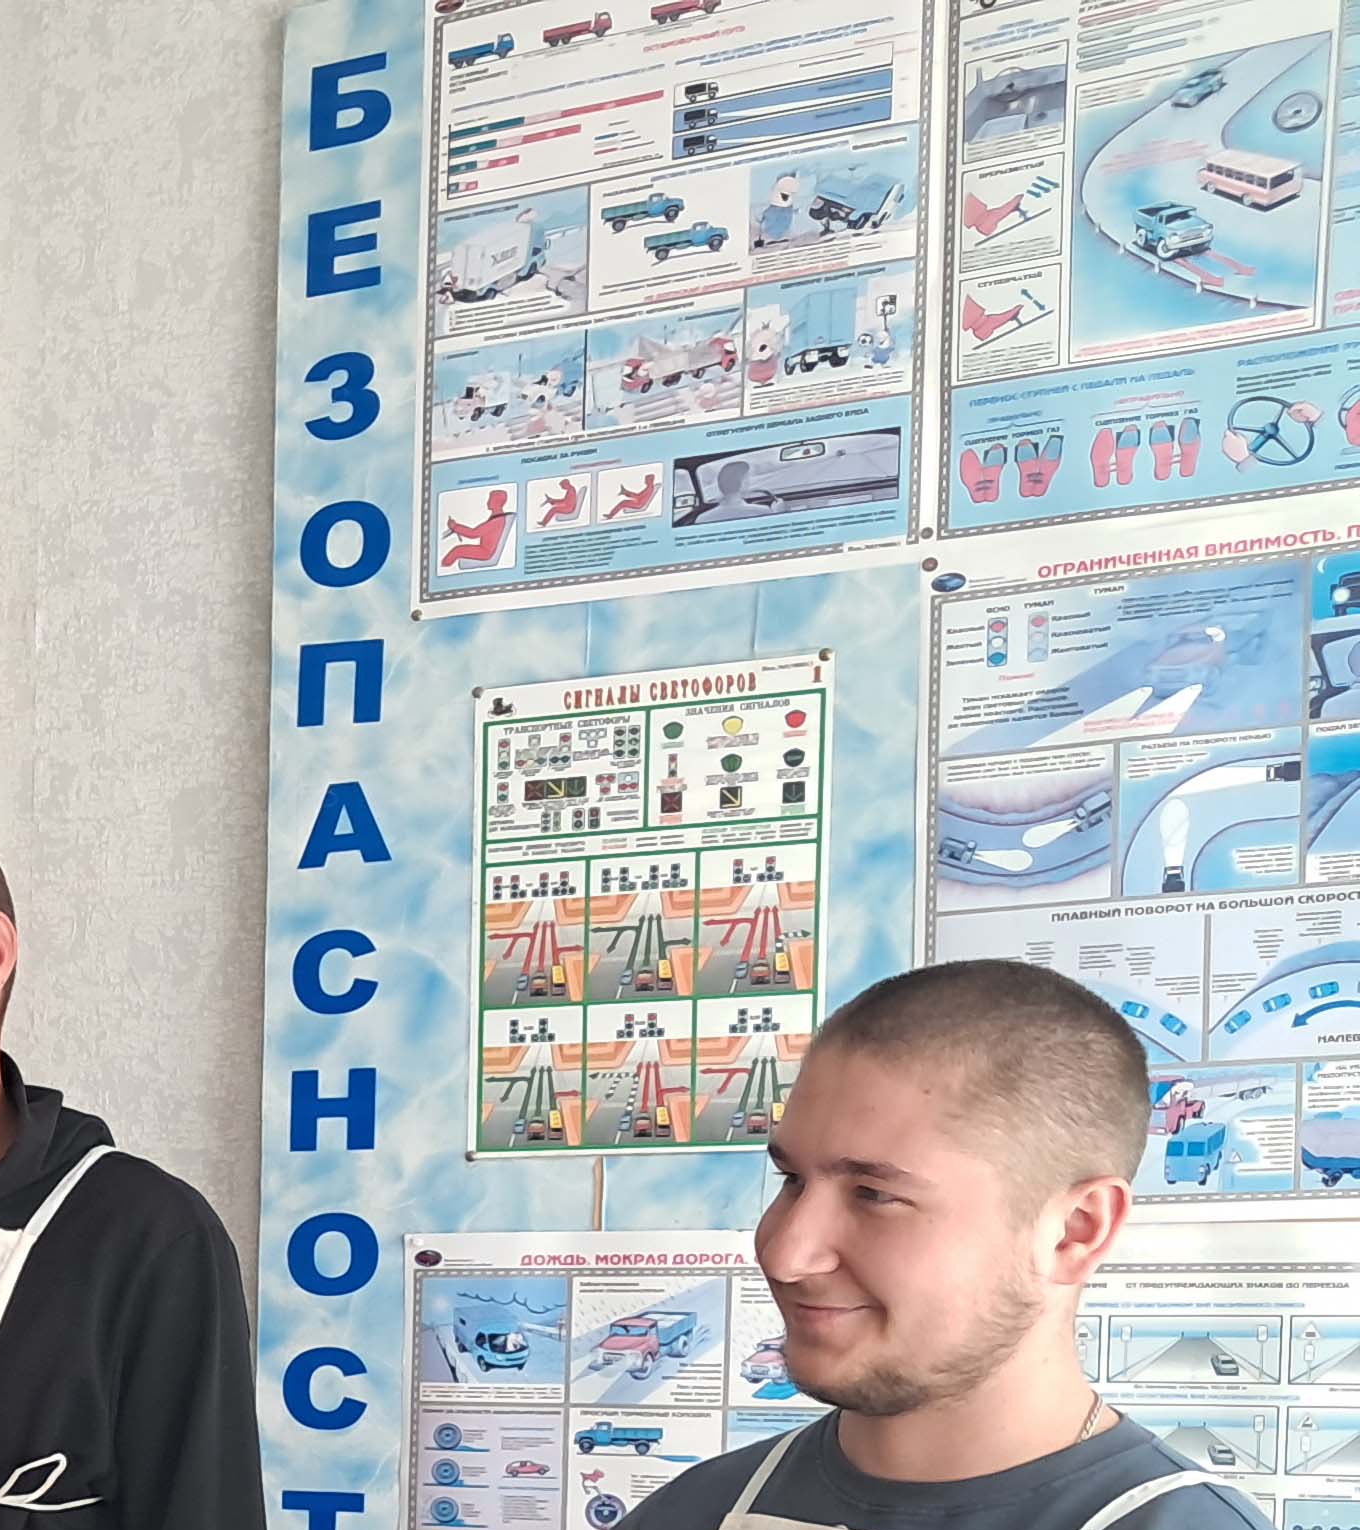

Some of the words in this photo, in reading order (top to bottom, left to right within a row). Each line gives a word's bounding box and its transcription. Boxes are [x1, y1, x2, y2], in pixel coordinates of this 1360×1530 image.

[1037, 545, 1199, 579] ОГРАНИЧЕННАЯ
[1204, 529, 1342, 558] ВИДИМОСТЬ.
[812, 666, 823, 683] 1
[563, 682, 641, 711] СИГНАЛЫ
[649, 671, 758, 701] СВЕТОФОРОВ
[685, 703, 736, 717] ЗНАЧЕНИЯ
[739, 698, 791, 712] СИГНАЛОВ
[503, 719, 573, 736] ТРАНСПОРТНЫЕ
[577, 715, 631, 729] СВЕТОФОРЫ
[1051, 907, 1122, 923] ПЛАВНЫЙ
[1124, 902, 1194, 917] ПОВОРОТ
[1195, 901, 1216, 912] НА
[1218, 894, 1294, 910] БОЛЬШОЙ
[519, 1254, 591, 1267] ДОЖДЬ.
[594, 1253, 669, 1266] МОКРАЯ
[672, 1253, 749, 1266] ДОРОГА.
